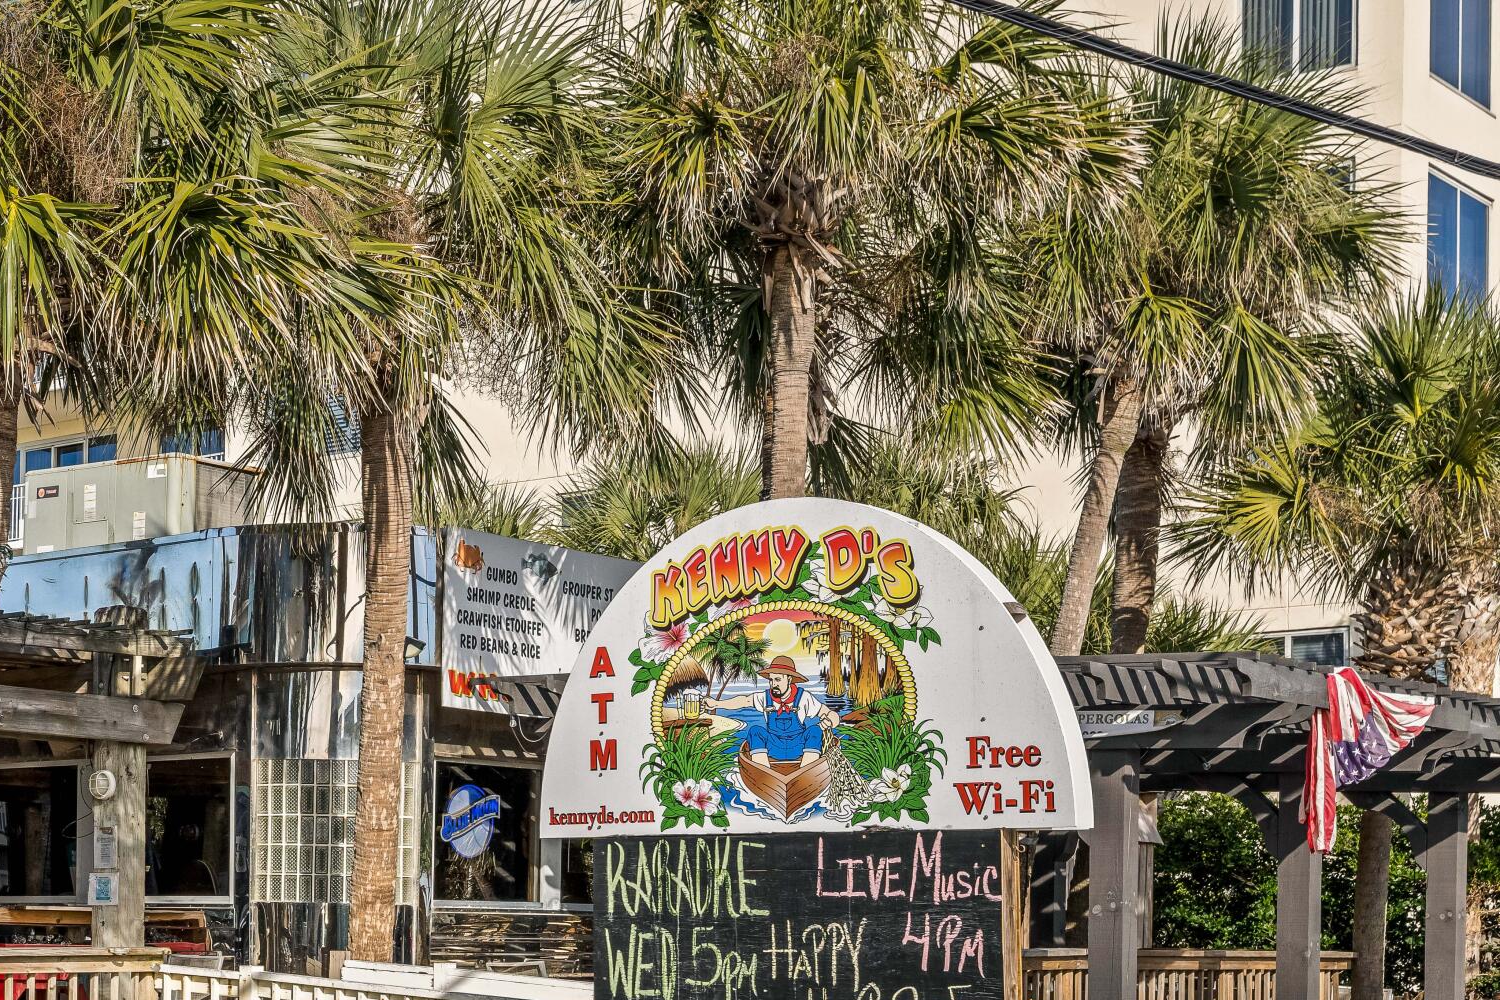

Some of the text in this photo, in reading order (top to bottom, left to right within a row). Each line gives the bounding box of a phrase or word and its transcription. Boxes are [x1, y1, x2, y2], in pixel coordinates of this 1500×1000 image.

[486, 566, 518, 585] GUMBO
[649, 524, 921, 629] KENNY D'S
[467, 586, 536, 612] SHRIMP CREOLE
[562, 580, 602, 601] GROUPER
[457, 609, 502, 630] CRAWFISH
[460, 633, 541, 660] RED BEANS & RICE
[589, 646, 618, 772] ATM
[966, 736, 1042, 770] Free
[953, 780, 1056, 816] Wi-Fi
[549, 807, 655, 831] kennyds.com
